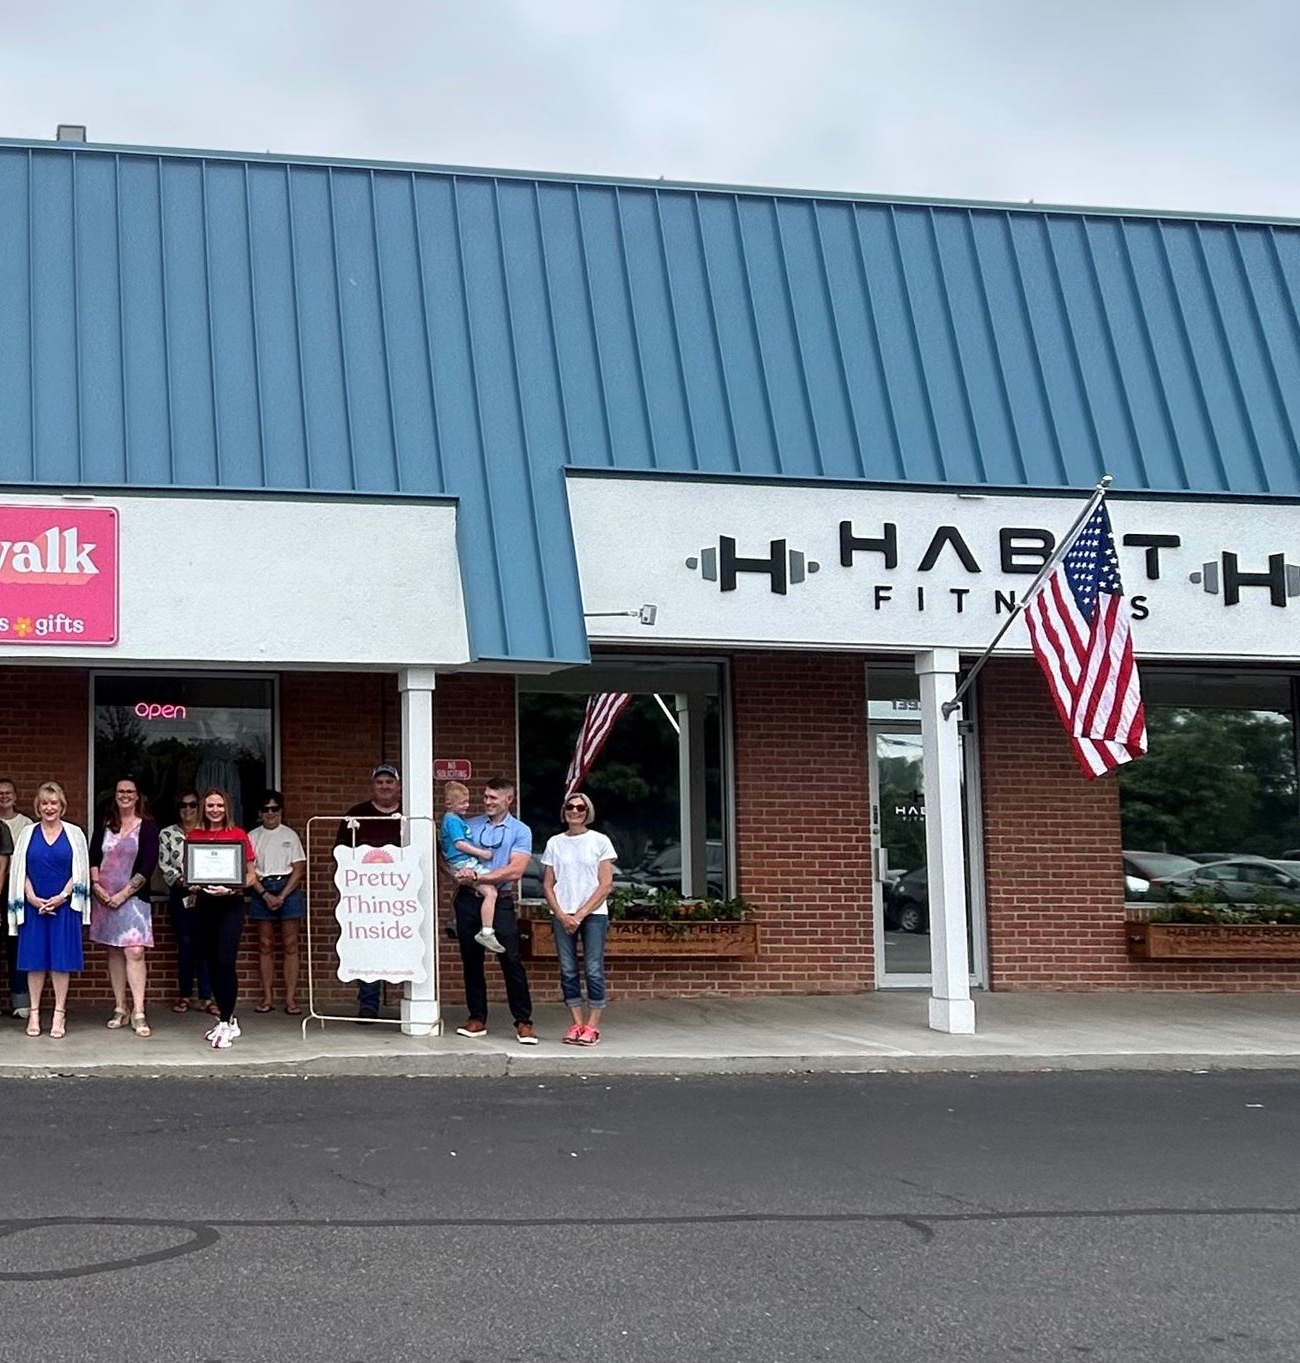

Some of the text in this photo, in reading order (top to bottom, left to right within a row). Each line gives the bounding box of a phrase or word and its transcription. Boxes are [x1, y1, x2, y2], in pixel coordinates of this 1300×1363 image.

[839, 520, 1181, 580] HABT
[874, 585, 1149, 620] FITNS
[35, 612, 85, 635] gifts
[134, 702, 187, 720] open
[891, 698, 922, 711] 139
[345, 869, 411, 891] Pretty
[342, 895, 418, 917] Things
[348, 920, 414, 940] Inside
[613, 924, 741, 935] TAKE ROT HERE
